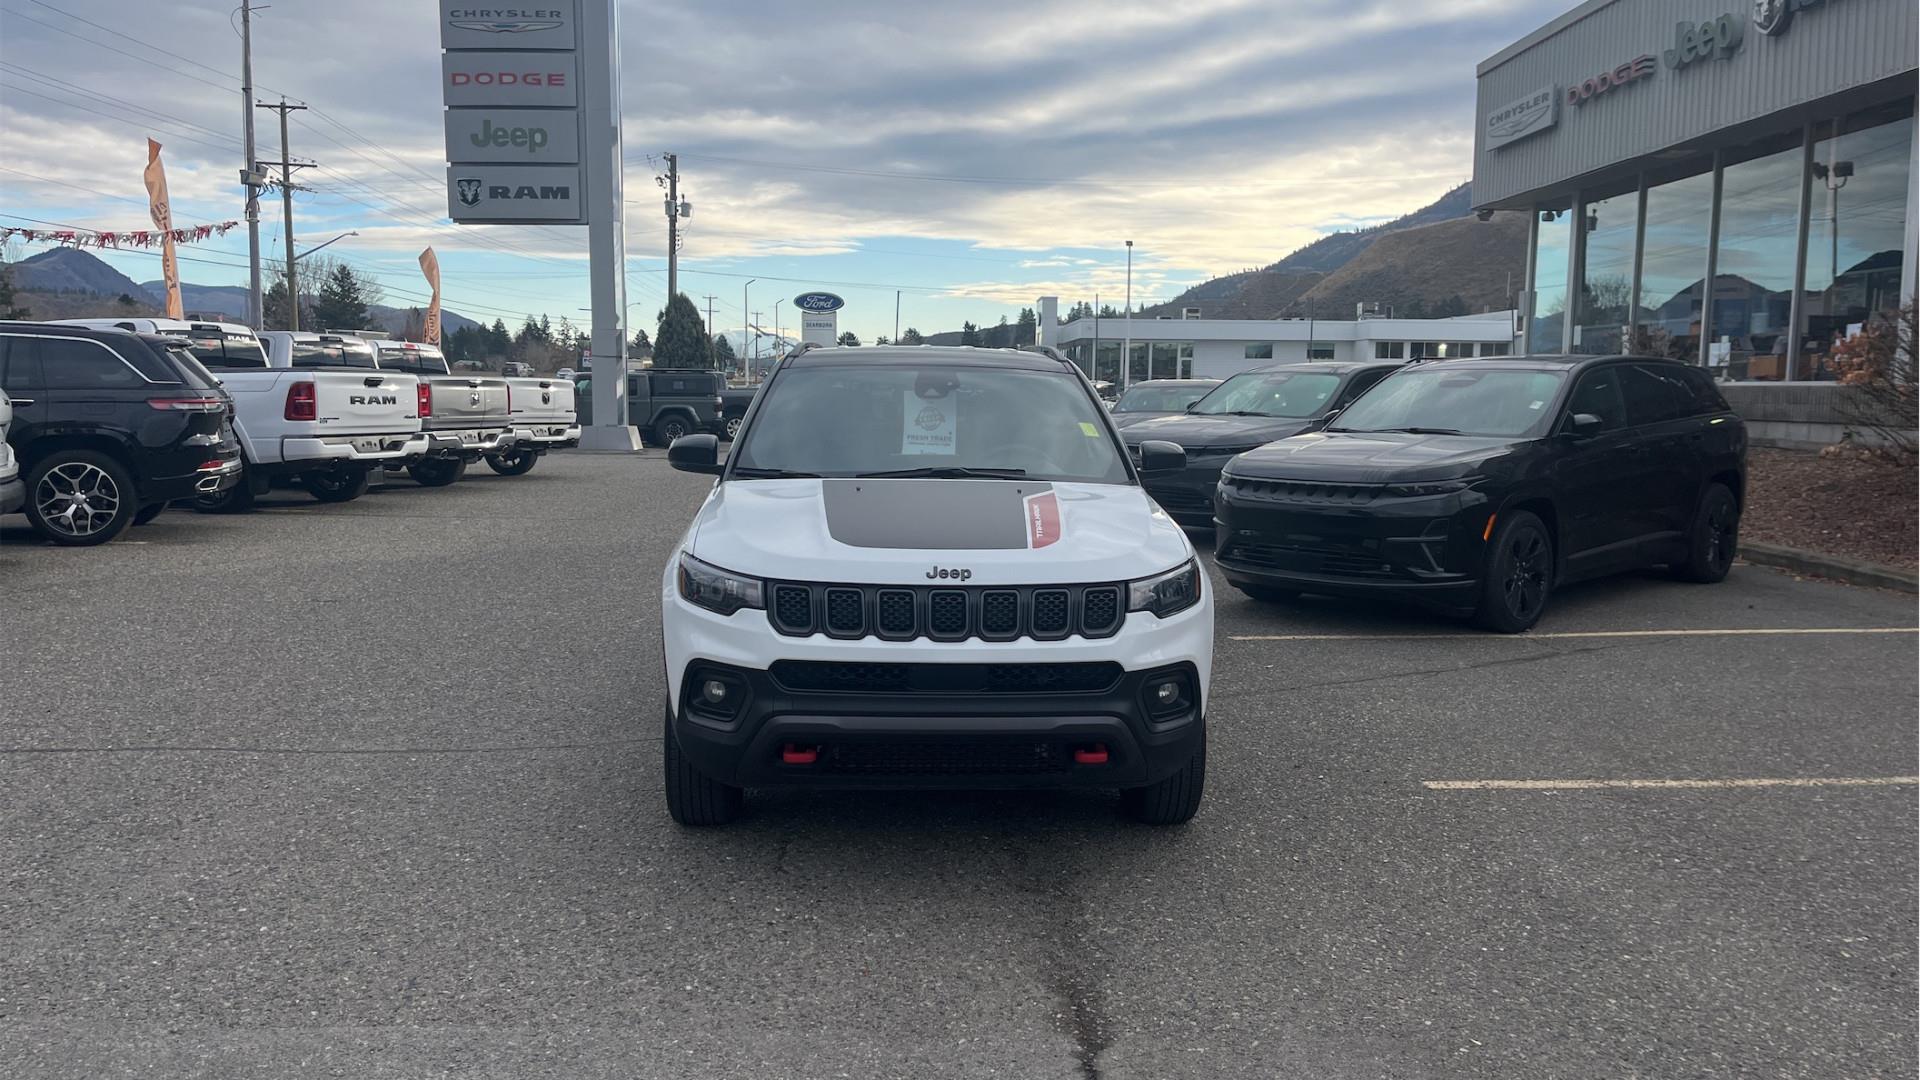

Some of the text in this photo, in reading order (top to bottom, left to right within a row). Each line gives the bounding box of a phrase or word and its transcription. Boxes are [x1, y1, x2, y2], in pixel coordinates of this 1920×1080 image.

[450, 9, 561, 18] CHRYSLER
[1664, 13, 1744, 70] Jeep
[452, 73, 565, 86] DODGE
[1568, 54, 1657, 105] DODGE
[1489, 92, 1550, 127] CHRYSLER
[470, 119, 548, 152] Jeep
[489, 186, 570, 199] RAM
[804, 295, 833, 308] Ford
[350, 396, 396, 405] RAM
[926, 566, 972, 581] Jeep
